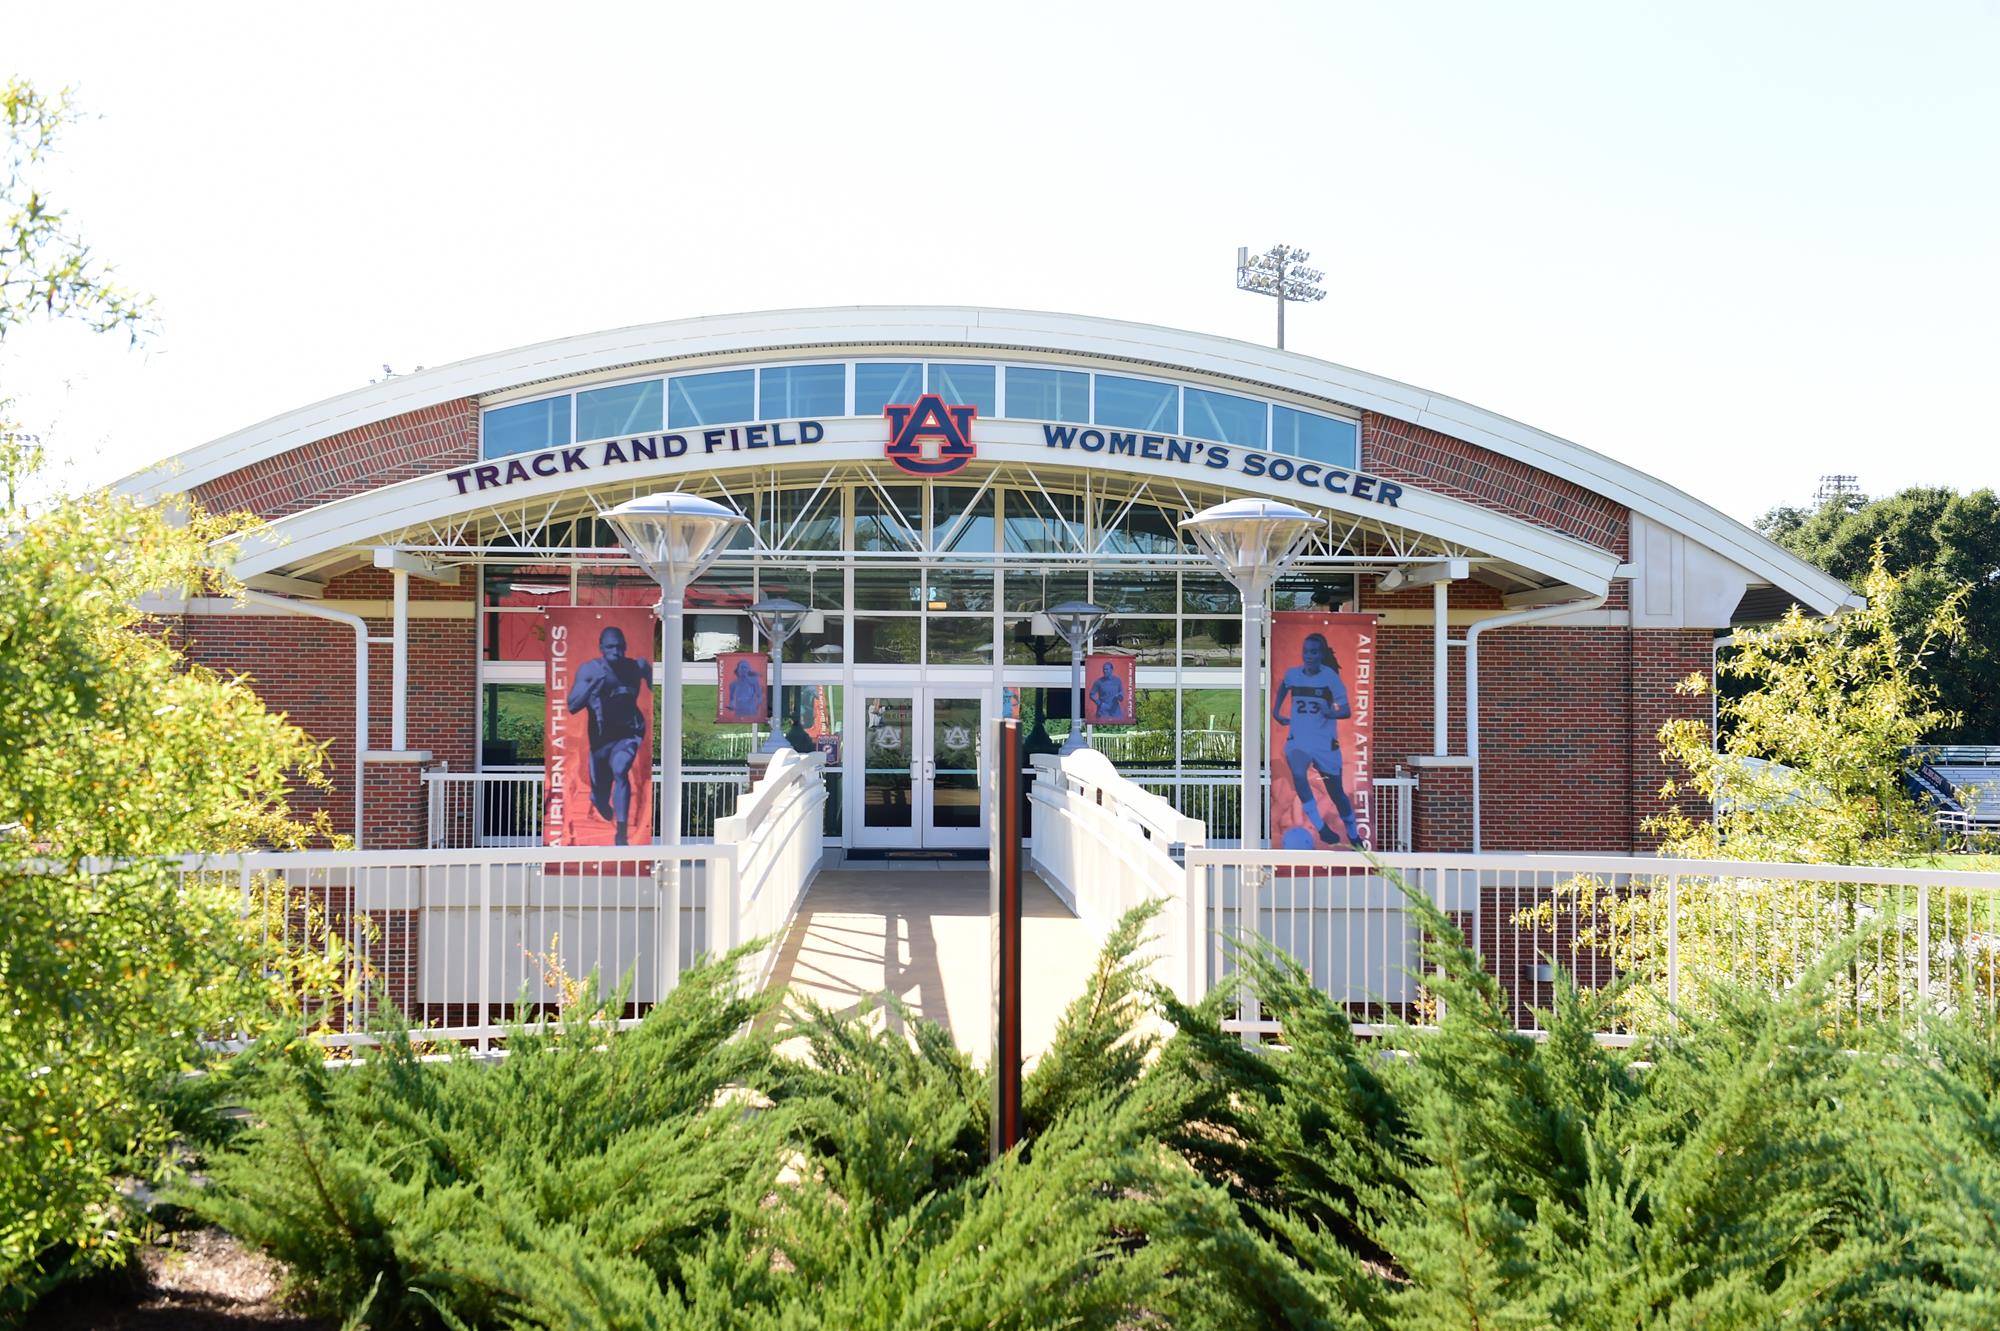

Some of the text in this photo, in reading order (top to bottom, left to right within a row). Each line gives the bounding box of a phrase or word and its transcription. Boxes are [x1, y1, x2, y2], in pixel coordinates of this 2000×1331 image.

[447, 420, 825, 496] TRACK AND FIELD
[1042, 424, 1404, 508] WOMEN'S SOCCER
[1296, 700, 1321, 714] 23
[1354, 633, 1372, 727] AUBURN
[549, 625, 568, 848] AUBURN ATHLETICS
